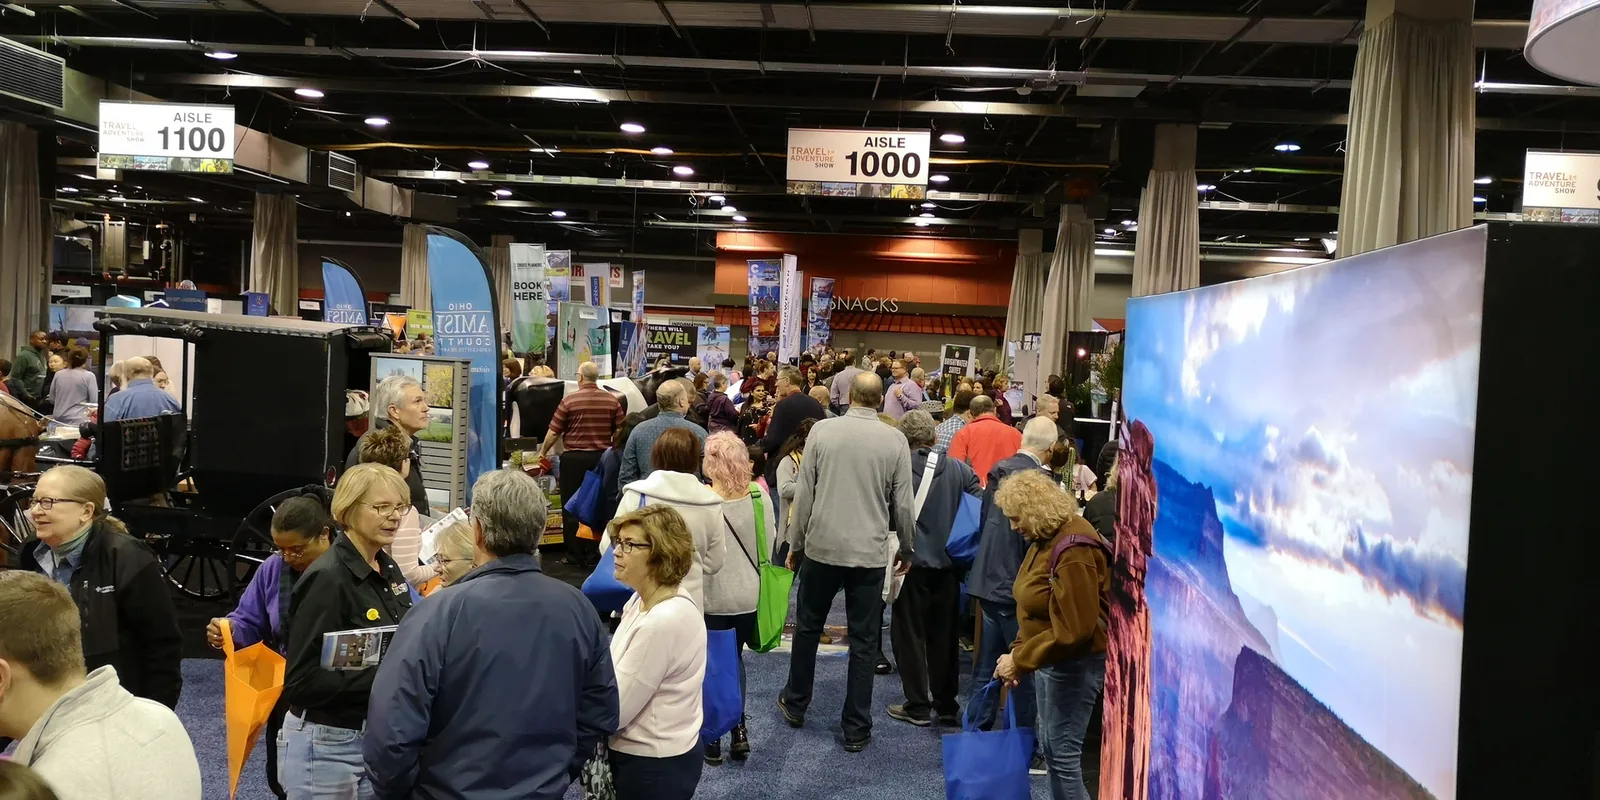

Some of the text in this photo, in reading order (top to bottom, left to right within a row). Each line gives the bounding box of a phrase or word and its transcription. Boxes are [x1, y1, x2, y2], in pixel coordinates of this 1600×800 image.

[174, 112, 212, 123] AISLE
[103, 122, 136, 130] TRAVEL
[158, 126, 225, 152] 1100
[864, 136, 906, 148] AISLE
[790, 146, 826, 155] TRAVEL
[845, 151, 921, 178] 1000
[1529, 172, 1568, 180] TRAVEL
[514, 282, 542, 290] BOOK
[514, 292, 542, 300] HERE
[647, 331, 691, 345] RAVEL
